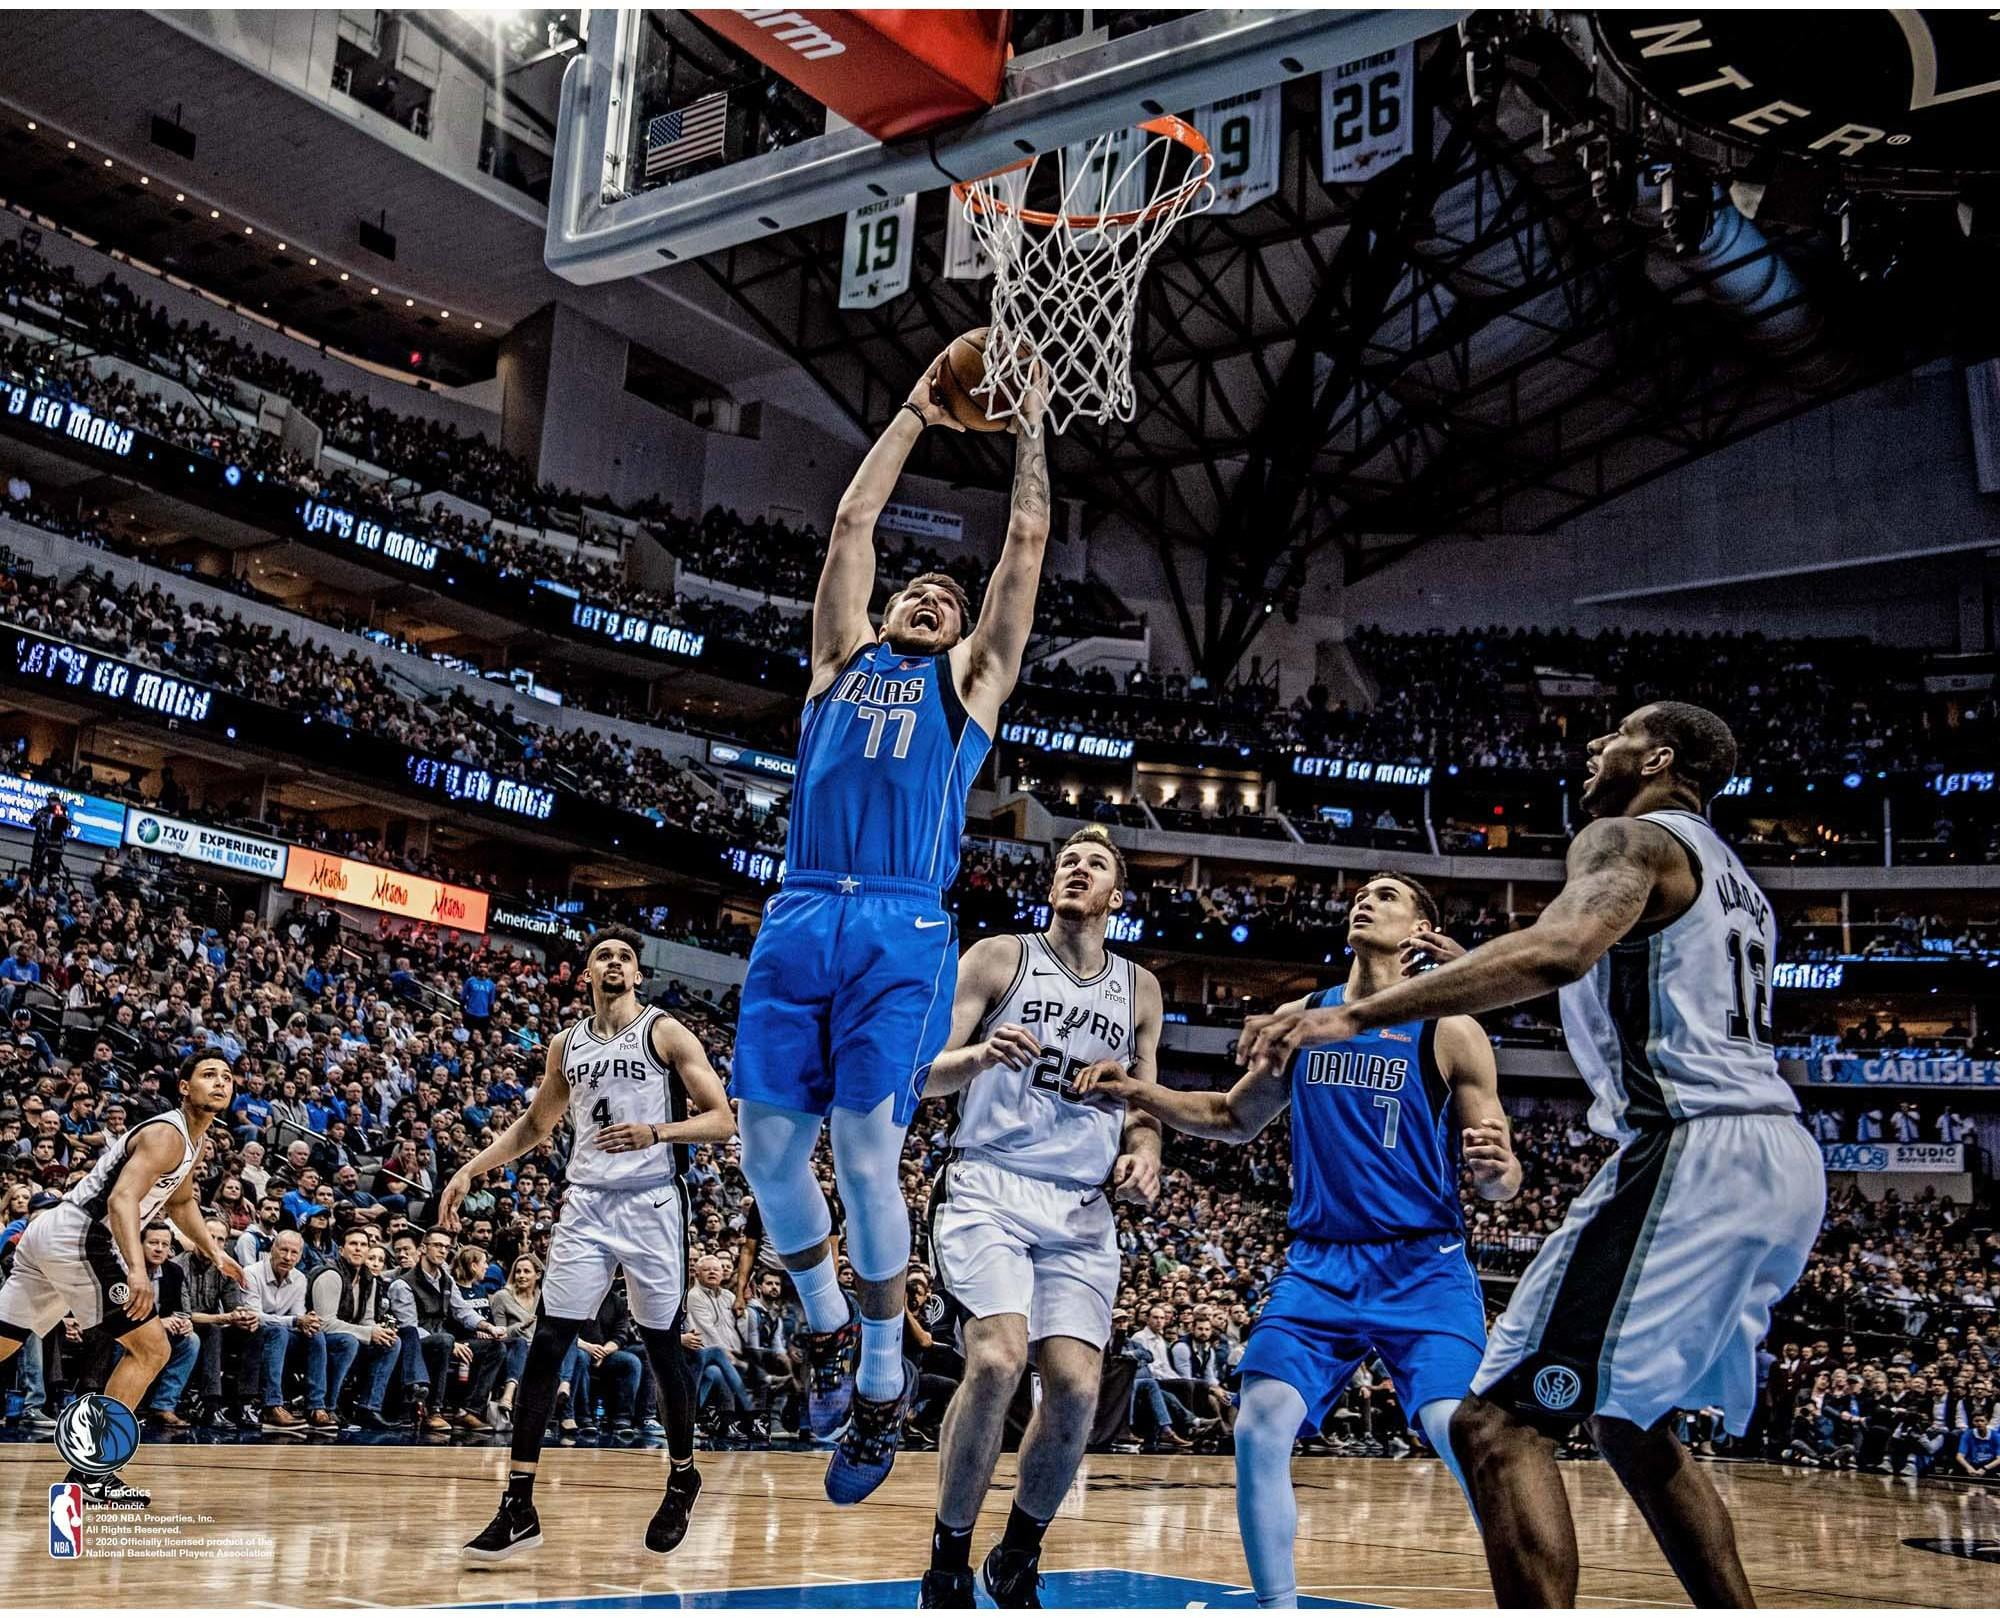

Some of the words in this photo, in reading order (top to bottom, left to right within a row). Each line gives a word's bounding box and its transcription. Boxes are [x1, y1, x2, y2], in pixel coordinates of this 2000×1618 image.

[1333, 71, 1400, 150] 26
[1220, 115, 1250, 180] 9
[856, 216, 899, 278] 19
[858, 706, 917, 759] 77
[163, 826, 189, 842] TXU
[200, 832, 279, 860] EXPERIENCE
[200, 845, 223, 859] THE
[226, 850, 277, 872] ENERGY
[1104, 990, 1127, 1005] Frost
[1021, 1000, 1124, 1051] SPURS
[620, 1042, 639, 1051] Frost
[567, 1059, 646, 1090] SPURS
[1306, 1051, 1408, 1092] DALLAS
[592, 1097, 613, 1129] 4
[1373, 1095, 1400, 1149] 7
[1896, 1147, 1957, 1157] STUDIO
